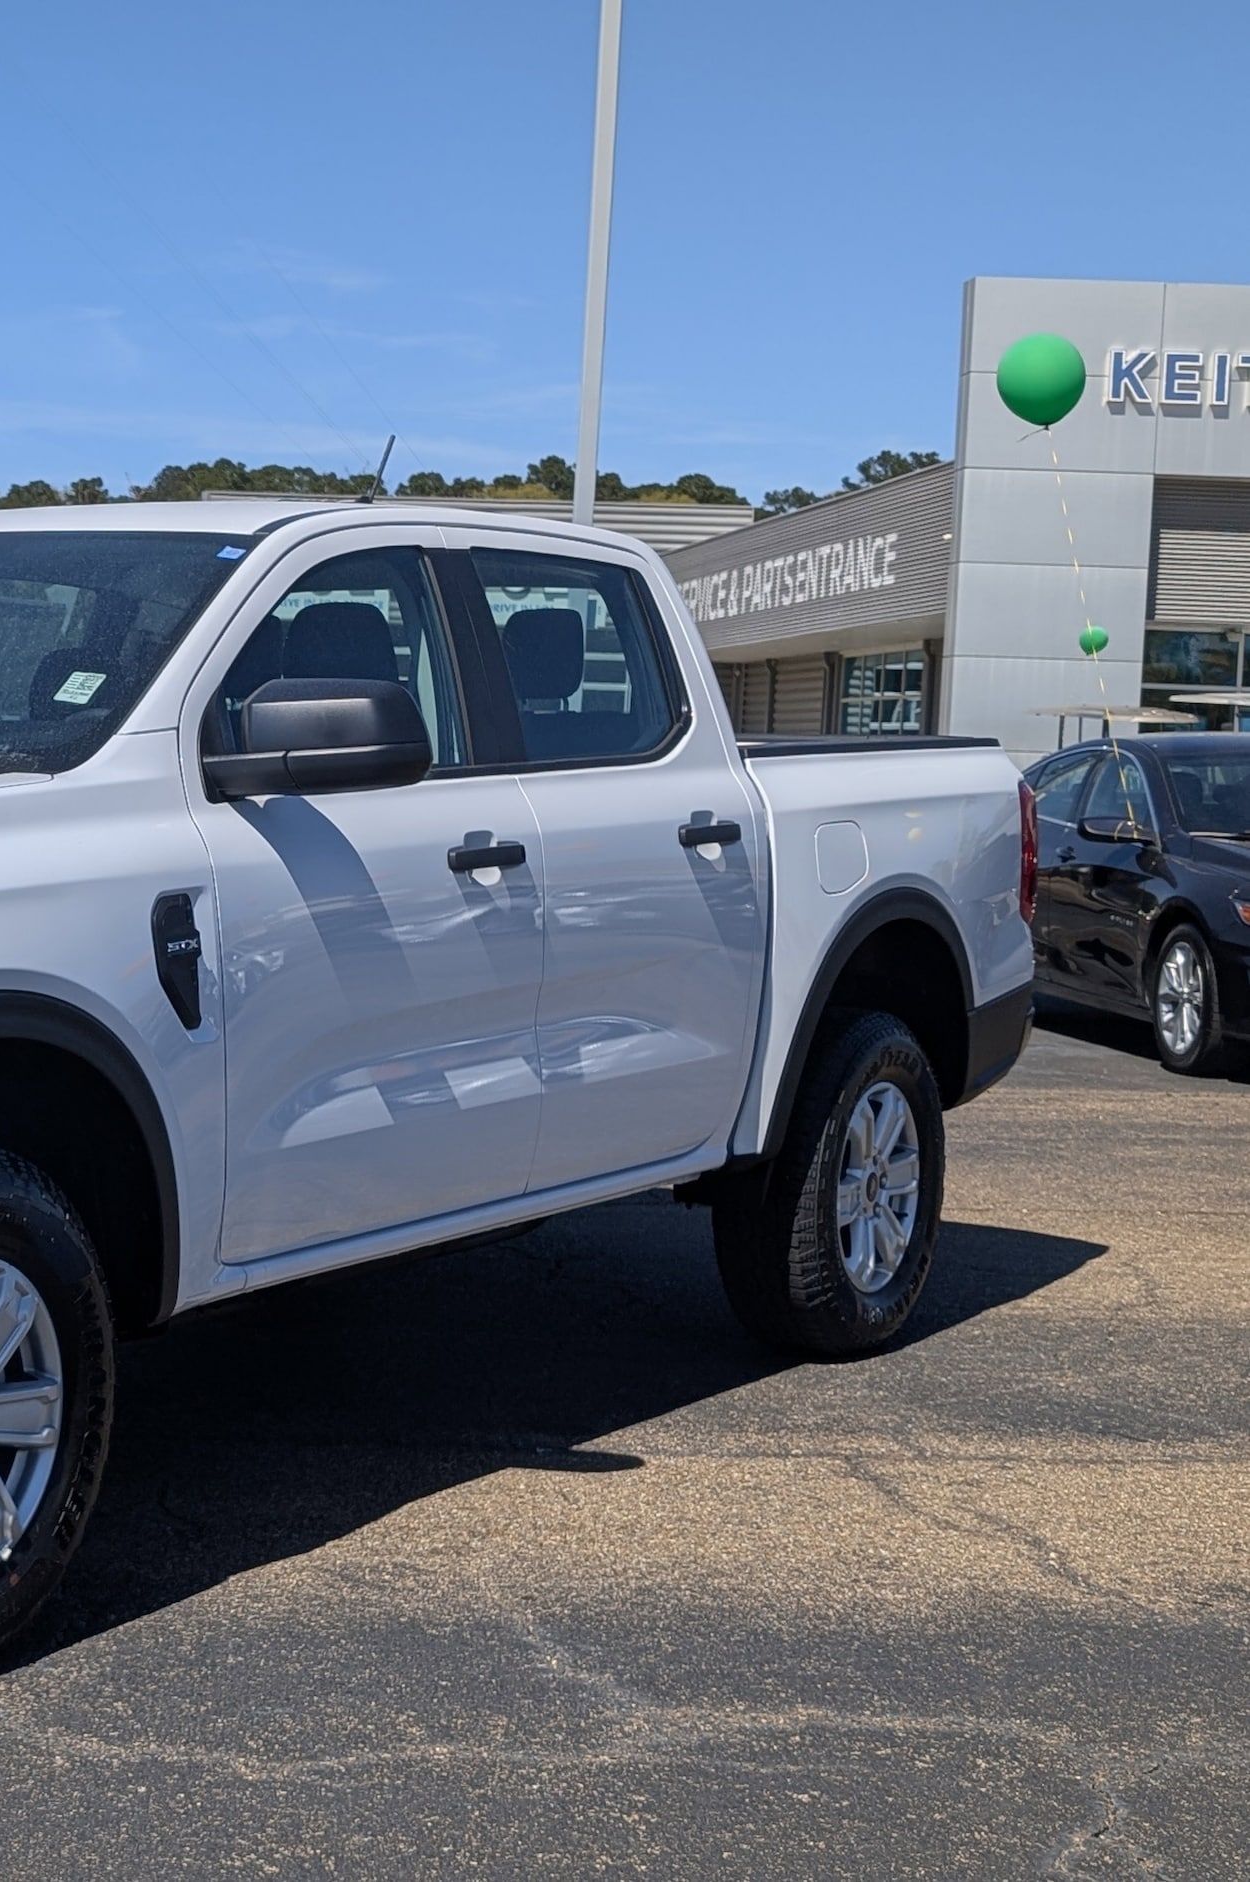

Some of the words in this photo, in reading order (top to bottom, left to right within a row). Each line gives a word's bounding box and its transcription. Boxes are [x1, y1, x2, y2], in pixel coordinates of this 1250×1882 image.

[678, 571, 729, 622] ERVICE
[740, 555, 795, 614] PARTS
[795, 532, 899, 603] ENTRANCE
[491, 603, 518, 613] RIVE
[167, 938, 199, 952] STX
